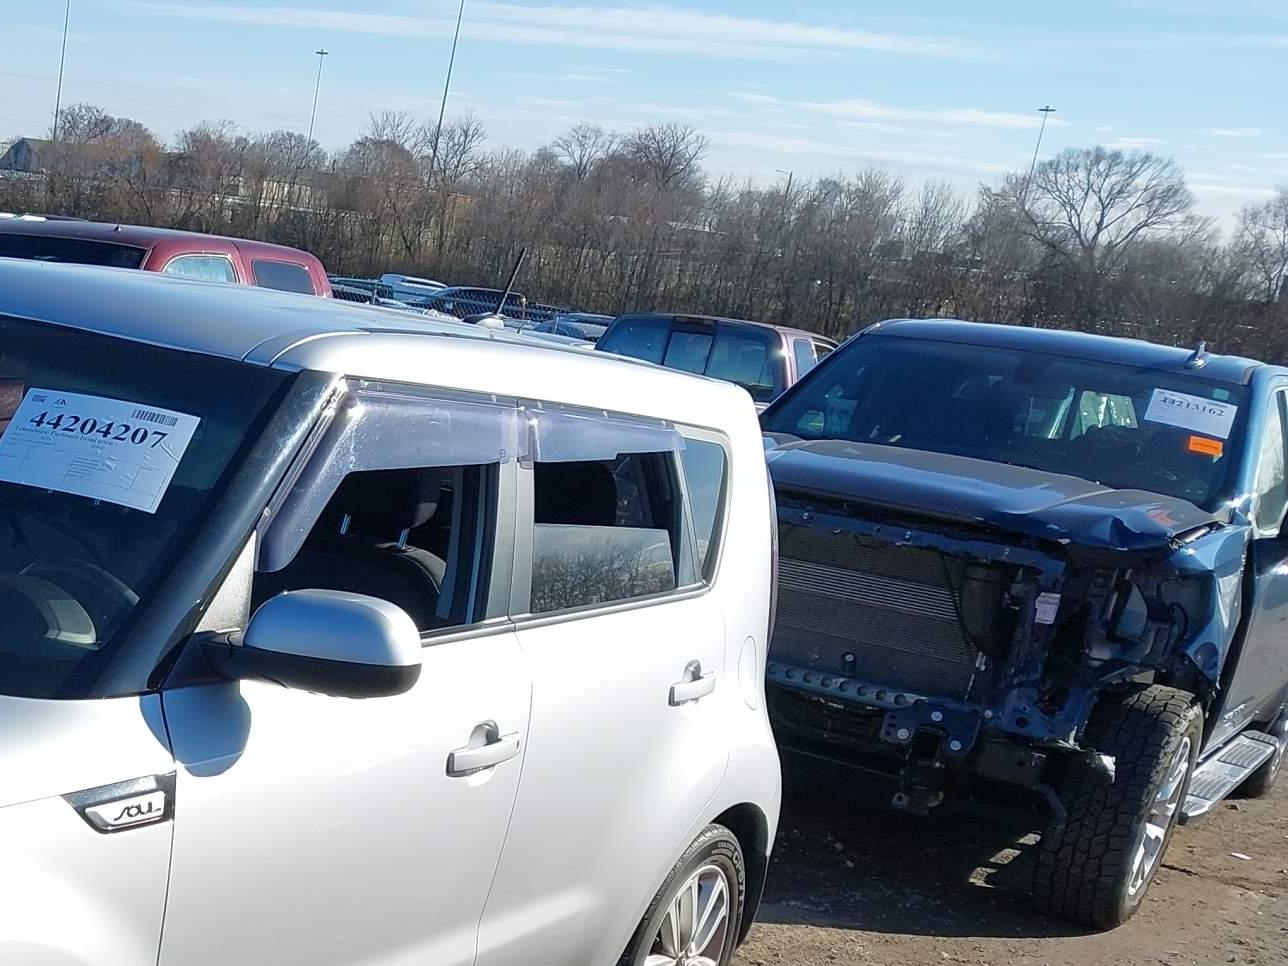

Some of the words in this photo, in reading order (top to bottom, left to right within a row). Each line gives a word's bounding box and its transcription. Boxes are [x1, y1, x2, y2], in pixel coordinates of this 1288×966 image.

[1159, 396, 1225, 417] 44213162
[30, 409, 169, 449] 44204207
[113, 801, 162, 821] SOUL
